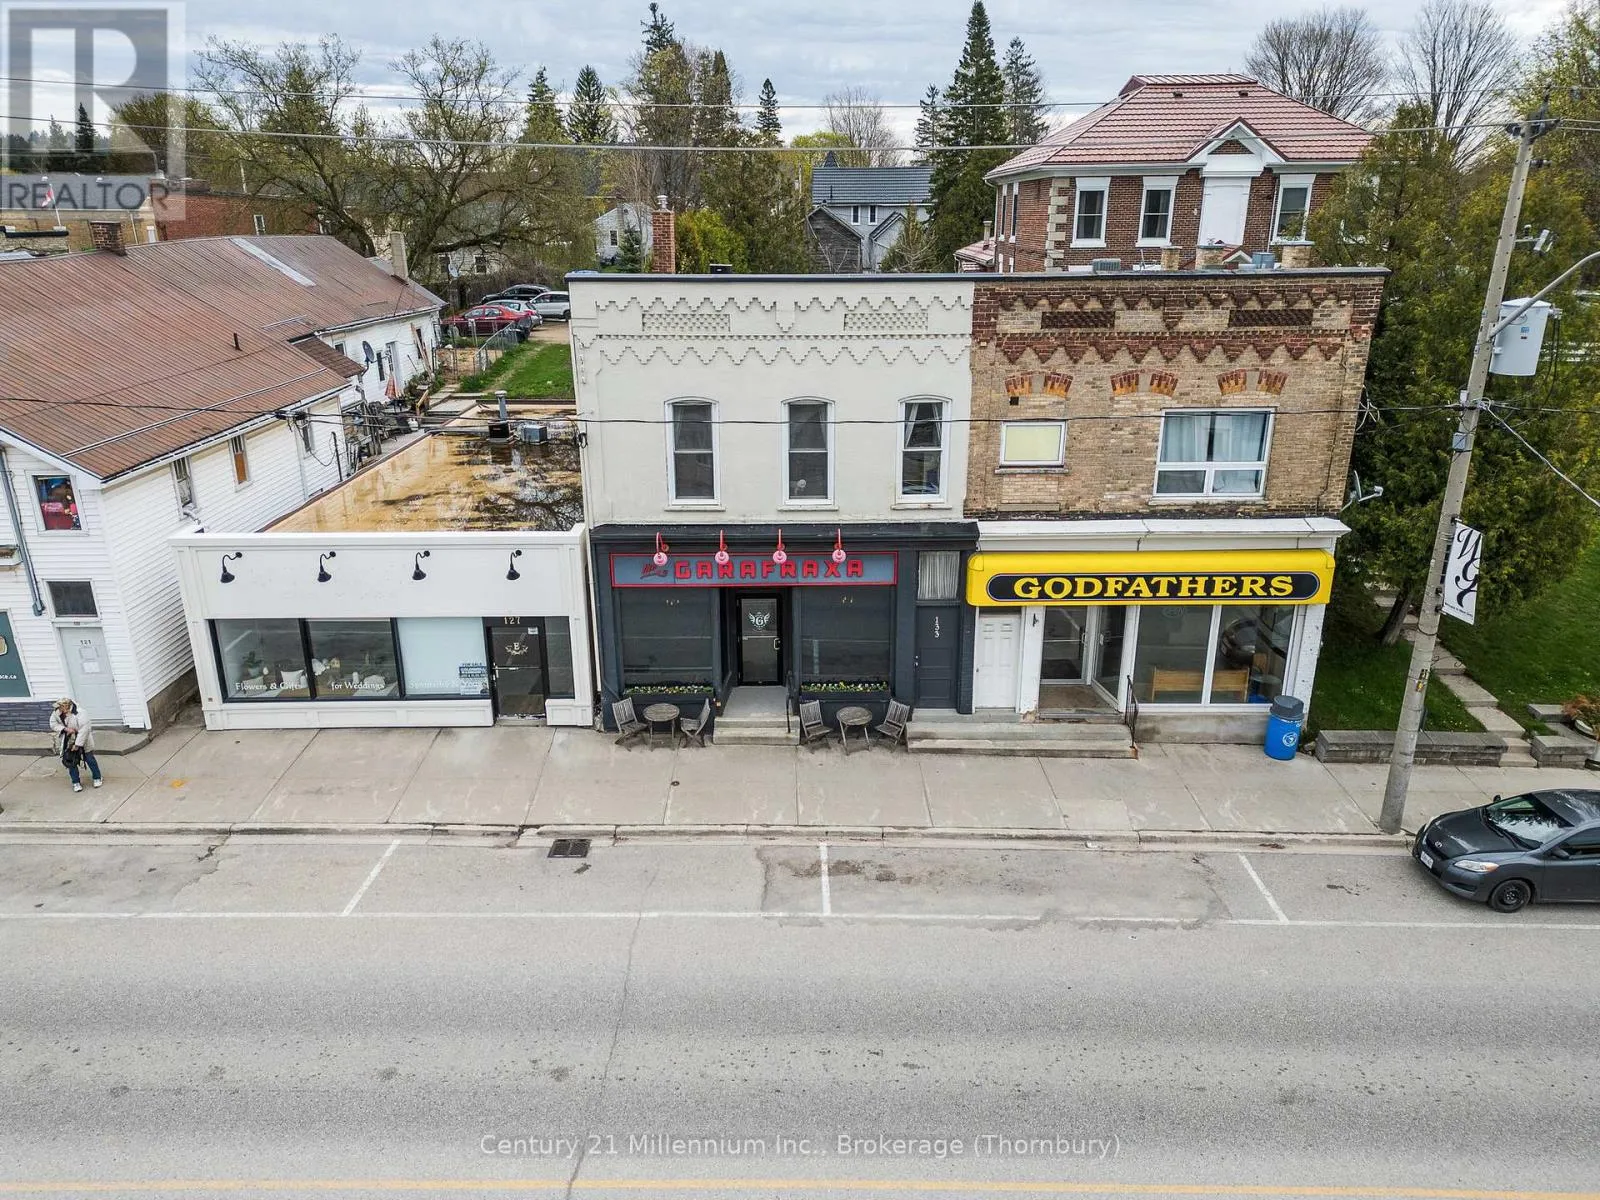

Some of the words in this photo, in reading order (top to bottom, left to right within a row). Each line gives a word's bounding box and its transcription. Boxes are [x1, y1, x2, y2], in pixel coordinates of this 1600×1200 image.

[674, 560, 864, 580] GARAFRAXA
[1013, 575, 1294, 599] GODFATHERS
[235, 682, 267, 690] Flowers
[269, 682, 278, 690] &
[331, 682, 343, 691] for
[344, 681, 385, 692] Weddings
